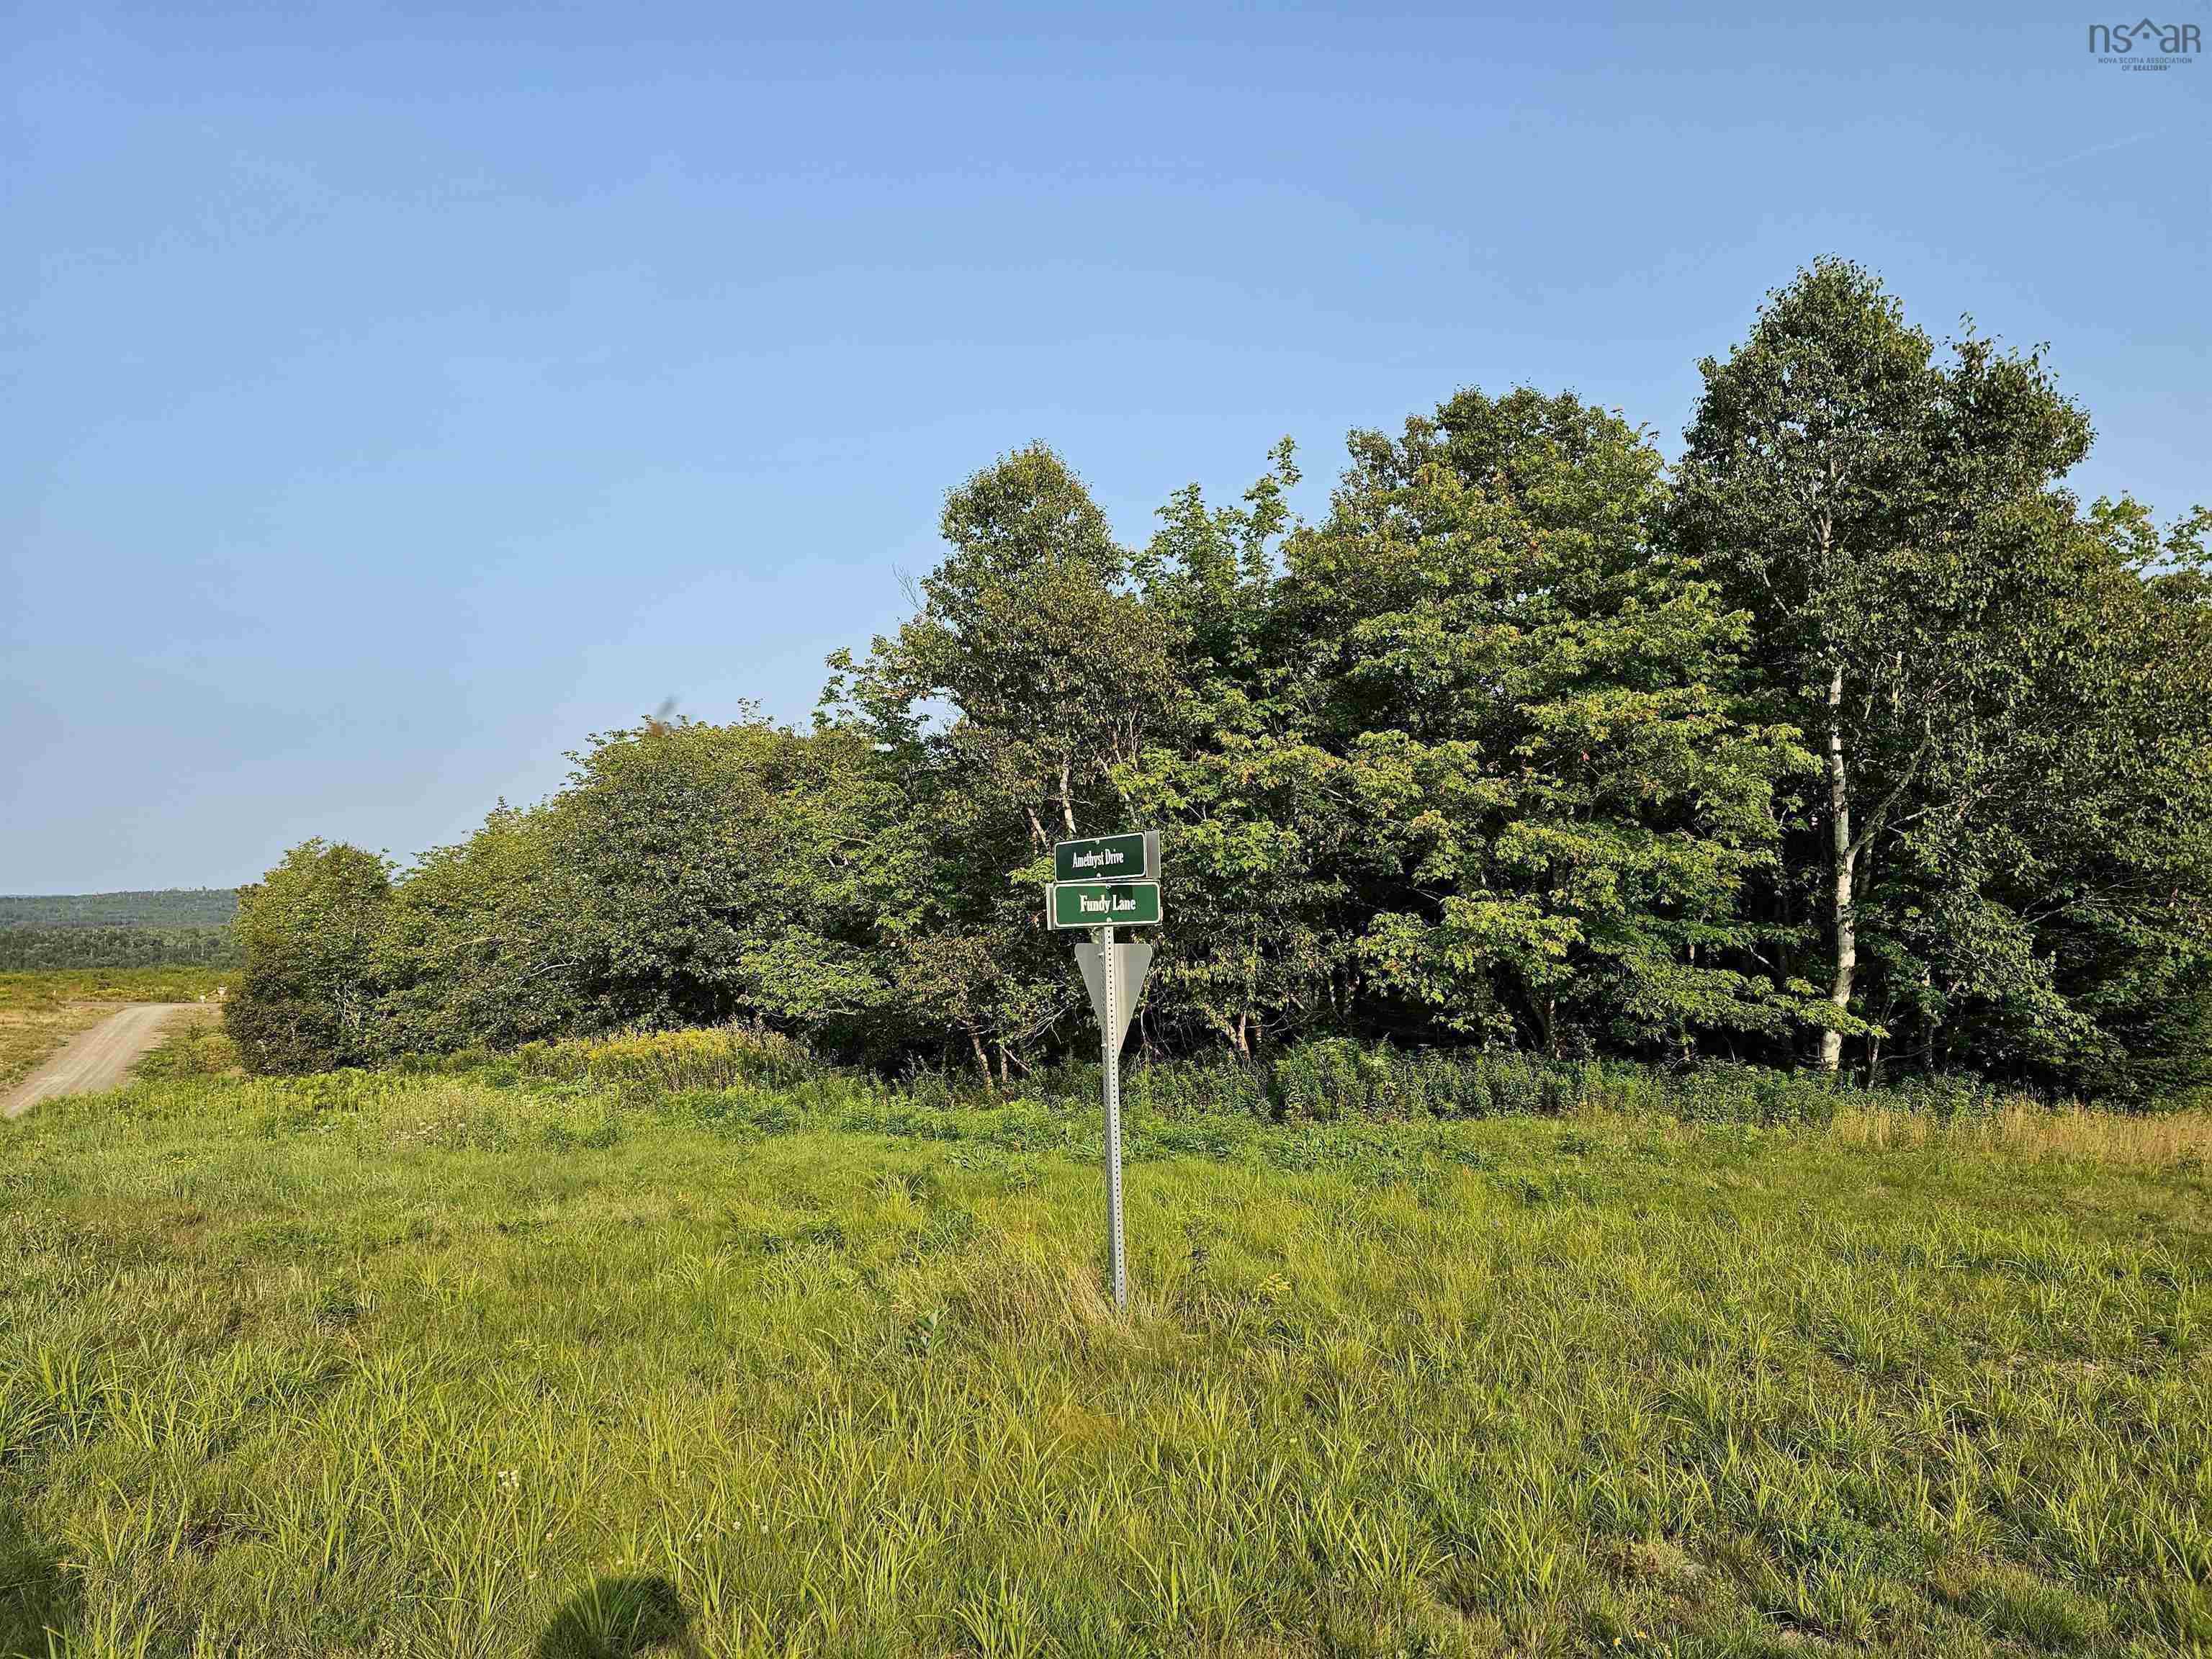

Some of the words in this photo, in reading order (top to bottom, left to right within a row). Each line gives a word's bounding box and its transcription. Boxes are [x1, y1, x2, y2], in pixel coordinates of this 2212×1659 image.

[1072, 850, 1105, 868] Amethyst
[1105, 848, 1124, 866] Drive
[1079, 894, 1111, 913] Fundy
[1112, 894, 1136, 911] Lane
